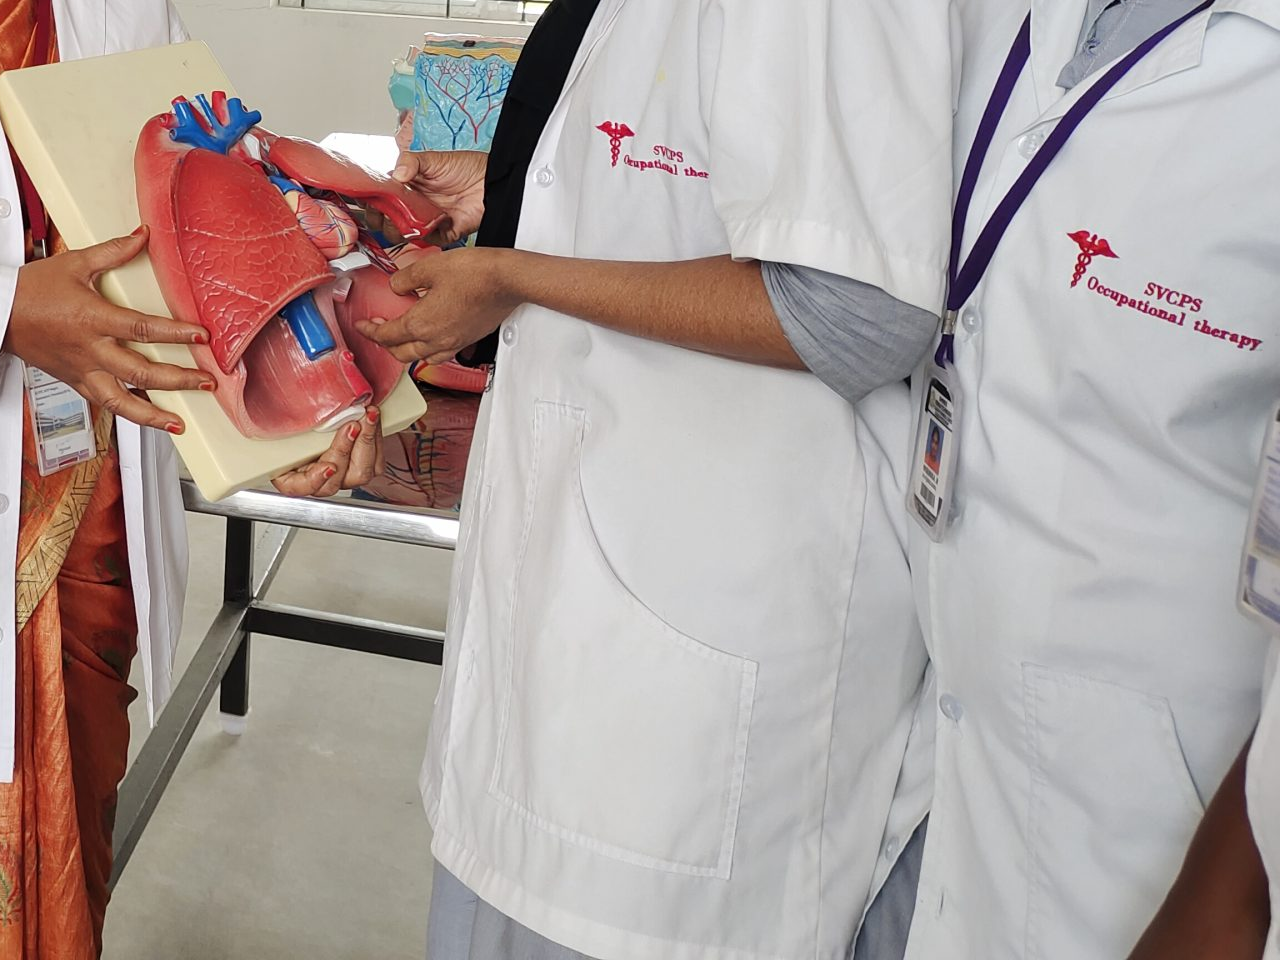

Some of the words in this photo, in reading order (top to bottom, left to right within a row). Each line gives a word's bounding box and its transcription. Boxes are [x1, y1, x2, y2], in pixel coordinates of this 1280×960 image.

[653, 145, 683, 163] SVCPS
[1144, 282, 1203, 313] SVCPS
[1087, 276, 1186, 327] Occupational
[1193, 319, 1263, 352] therapy
